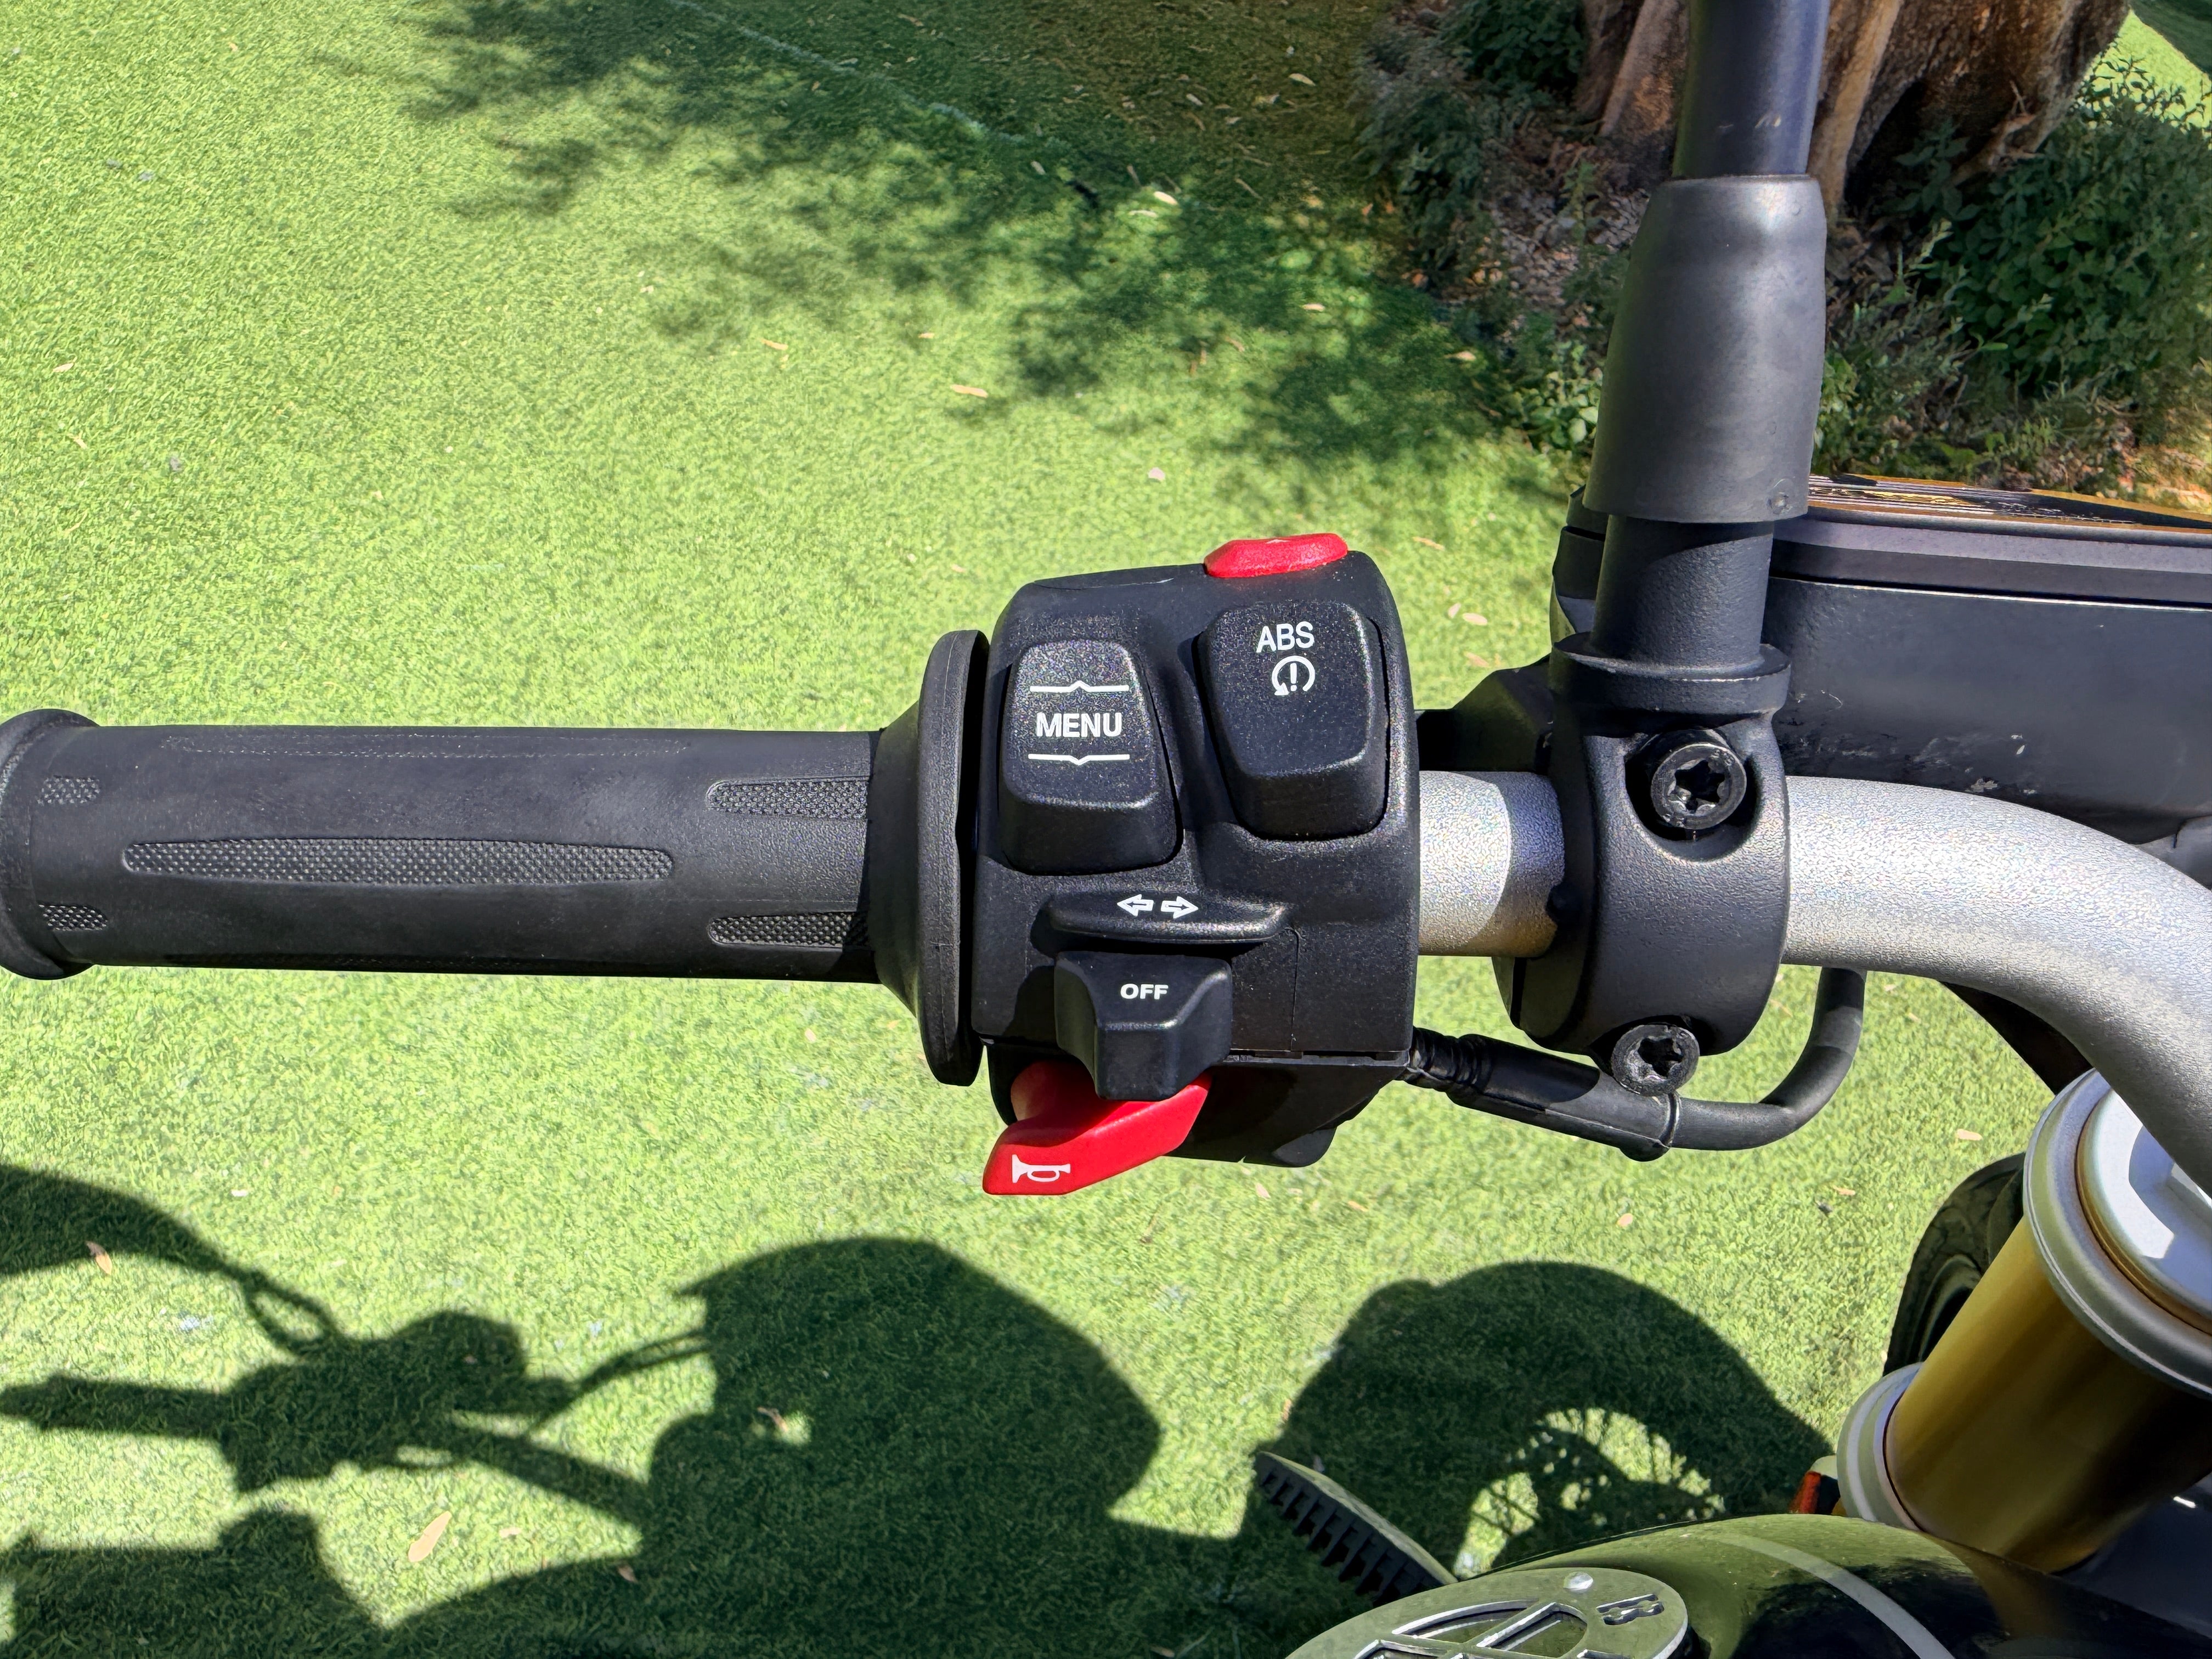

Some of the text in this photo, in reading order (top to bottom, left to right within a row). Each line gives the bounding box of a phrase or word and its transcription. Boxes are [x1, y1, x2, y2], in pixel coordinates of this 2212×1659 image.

[1255, 620, 1315, 653] ABS
[1035, 711, 1124, 739] MENU
[1120, 983, 1169, 1000] OFF
